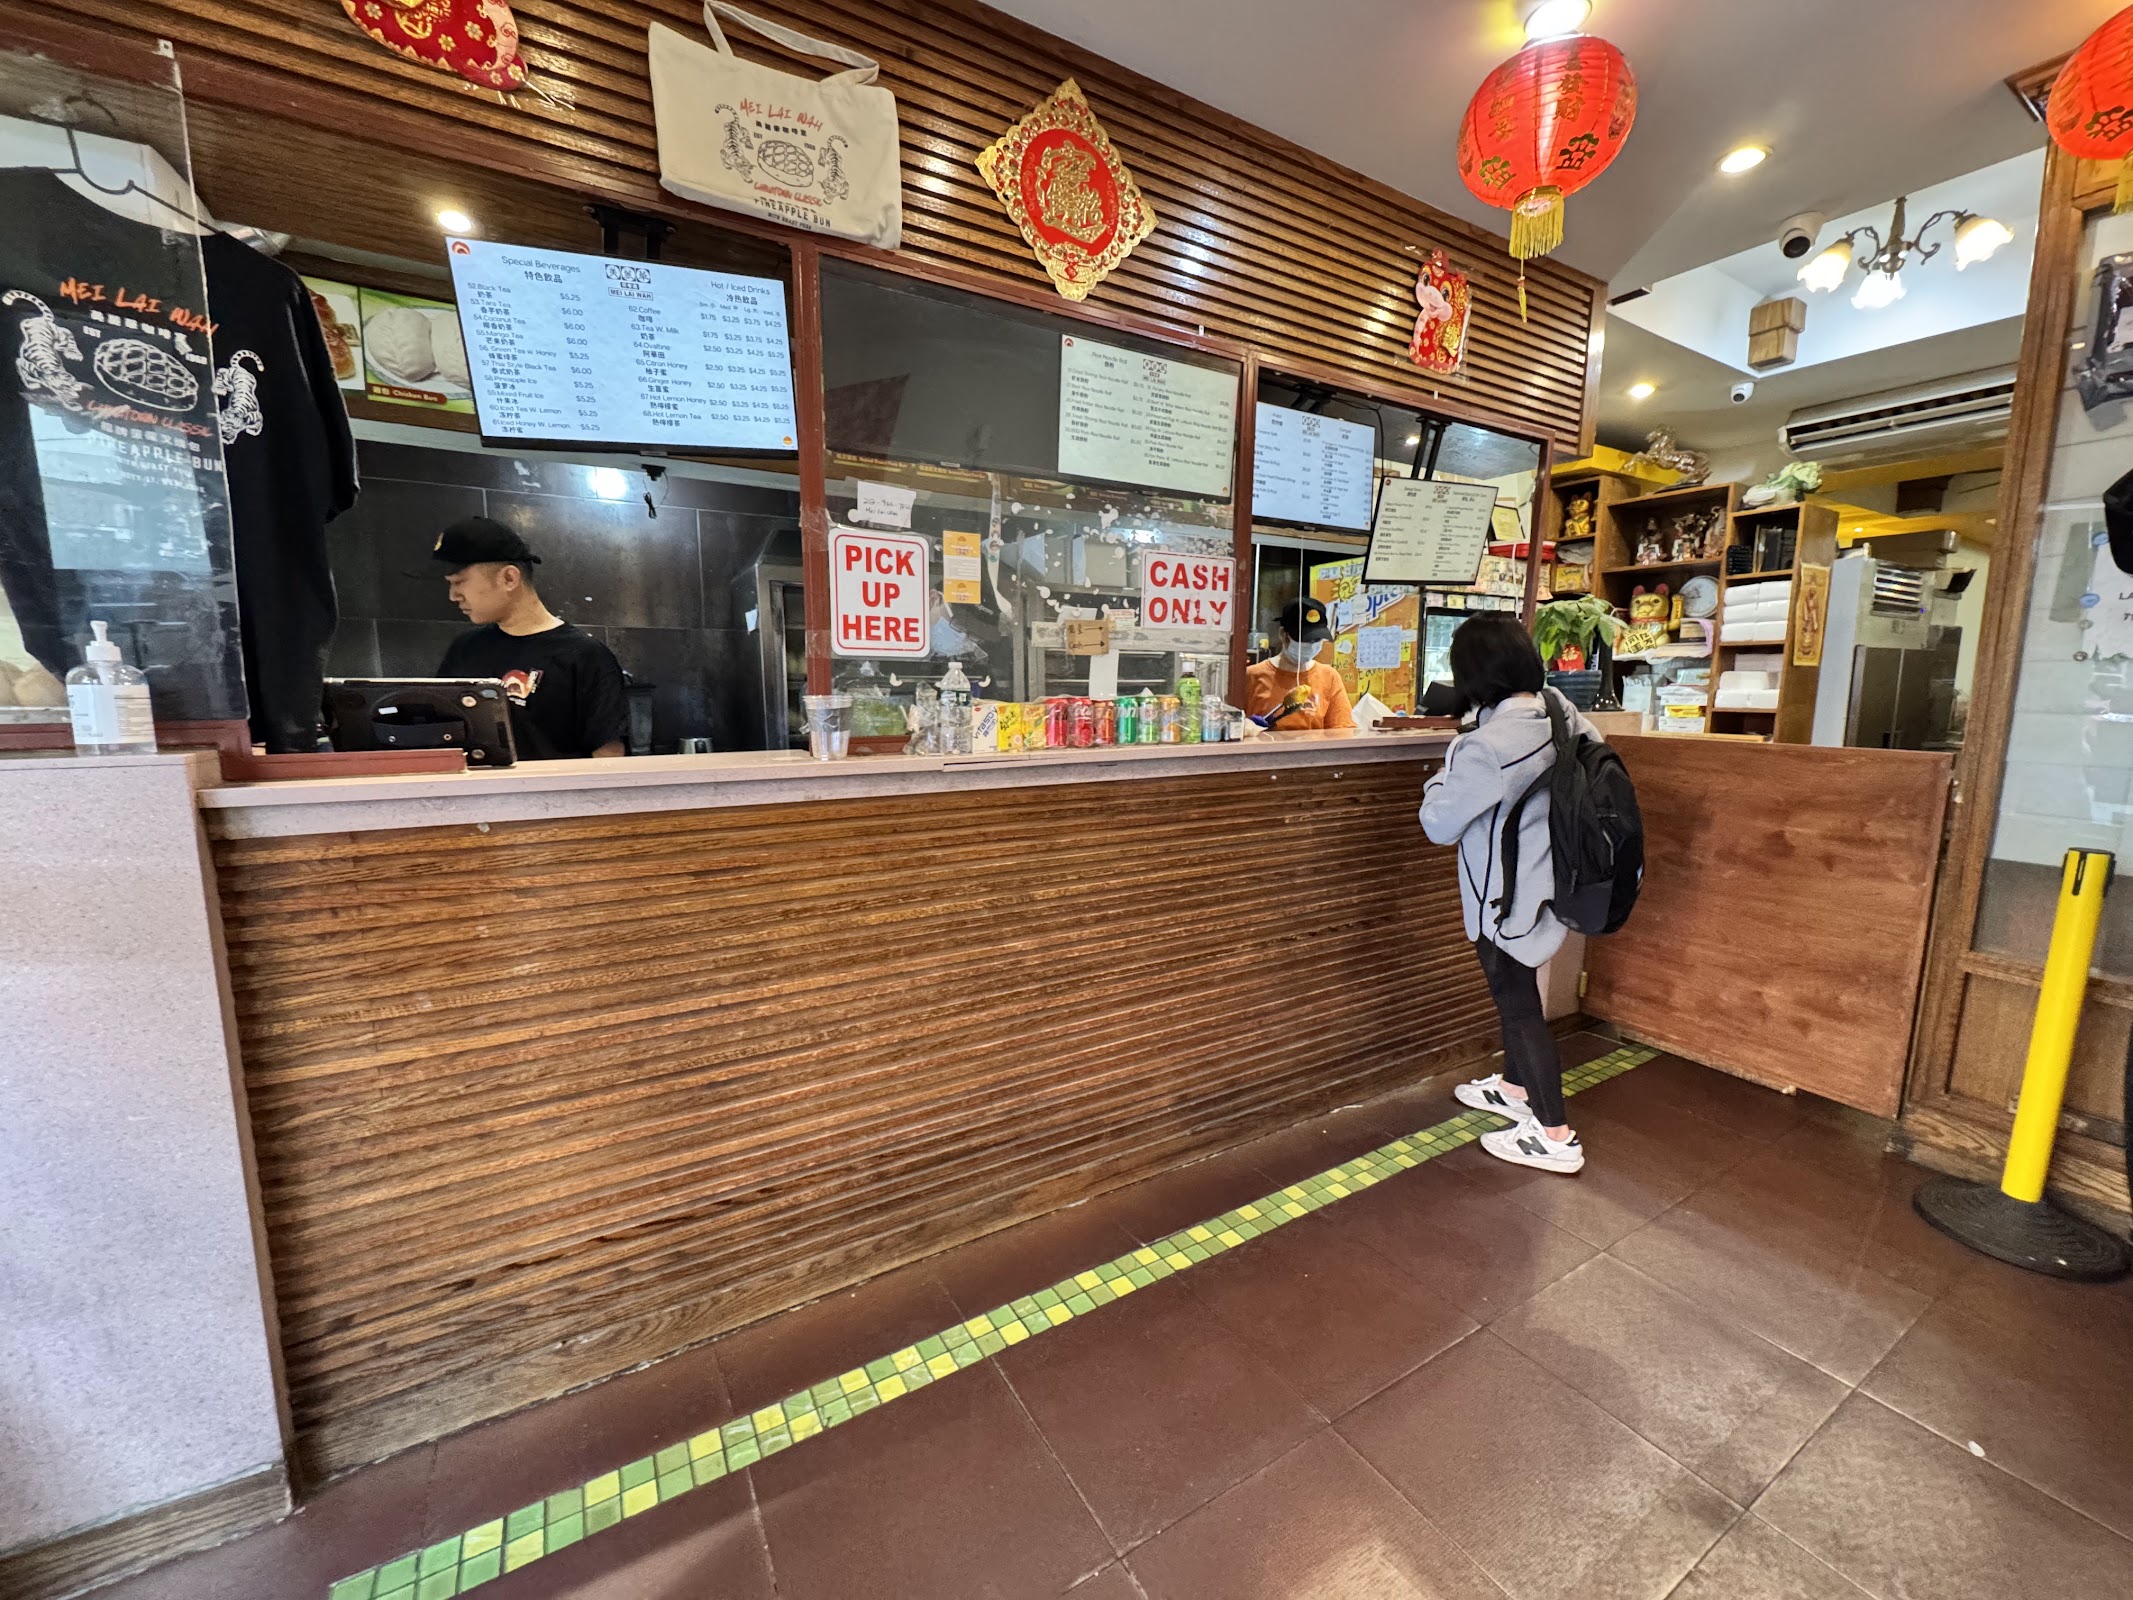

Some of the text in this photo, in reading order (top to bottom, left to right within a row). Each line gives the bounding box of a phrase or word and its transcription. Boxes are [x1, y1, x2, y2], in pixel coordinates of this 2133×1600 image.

[740, 98, 763, 117] MEI
[768, 104, 792, 119] LAI
[813, 213, 831, 228] BUN
[501, 256, 581, 273] Special Beverages
[60, 277, 106, 304] MEI
[115, 287, 162, 312] LAI
[636, 291, 652, 299] WAH
[711, 281, 724, 289] Hot
[731, 283, 746, 292] Iced
[747, 285, 771, 295] Drinks
[499, 300, 512, 308] Tea
[628, 305, 661, 315] 62.Coffee
[513, 317, 526, 325] Tea
[511, 331, 524, 339] Tea
[524, 363, 543, 371] Black
[543, 364, 557, 372] Tea
[667, 361, 688, 371] Honey
[671, 379, 692, 387] Honey
[392, 389, 422, 399] Chicken
[516, 405, 528, 413] Tea
[539, 407, 562, 415] Lemon
[515, 420, 536, 428] Honey
[192, 457, 224, 472] BUN
[845, 545, 915, 577] PICK
[1149, 560, 1230, 592] CASH
[861, 581, 900, 608] UP
[1148, 597, 1228, 626] ONLY
[842, 615, 920, 643] HERE
[1516, 1136, 1548, 1155] N
